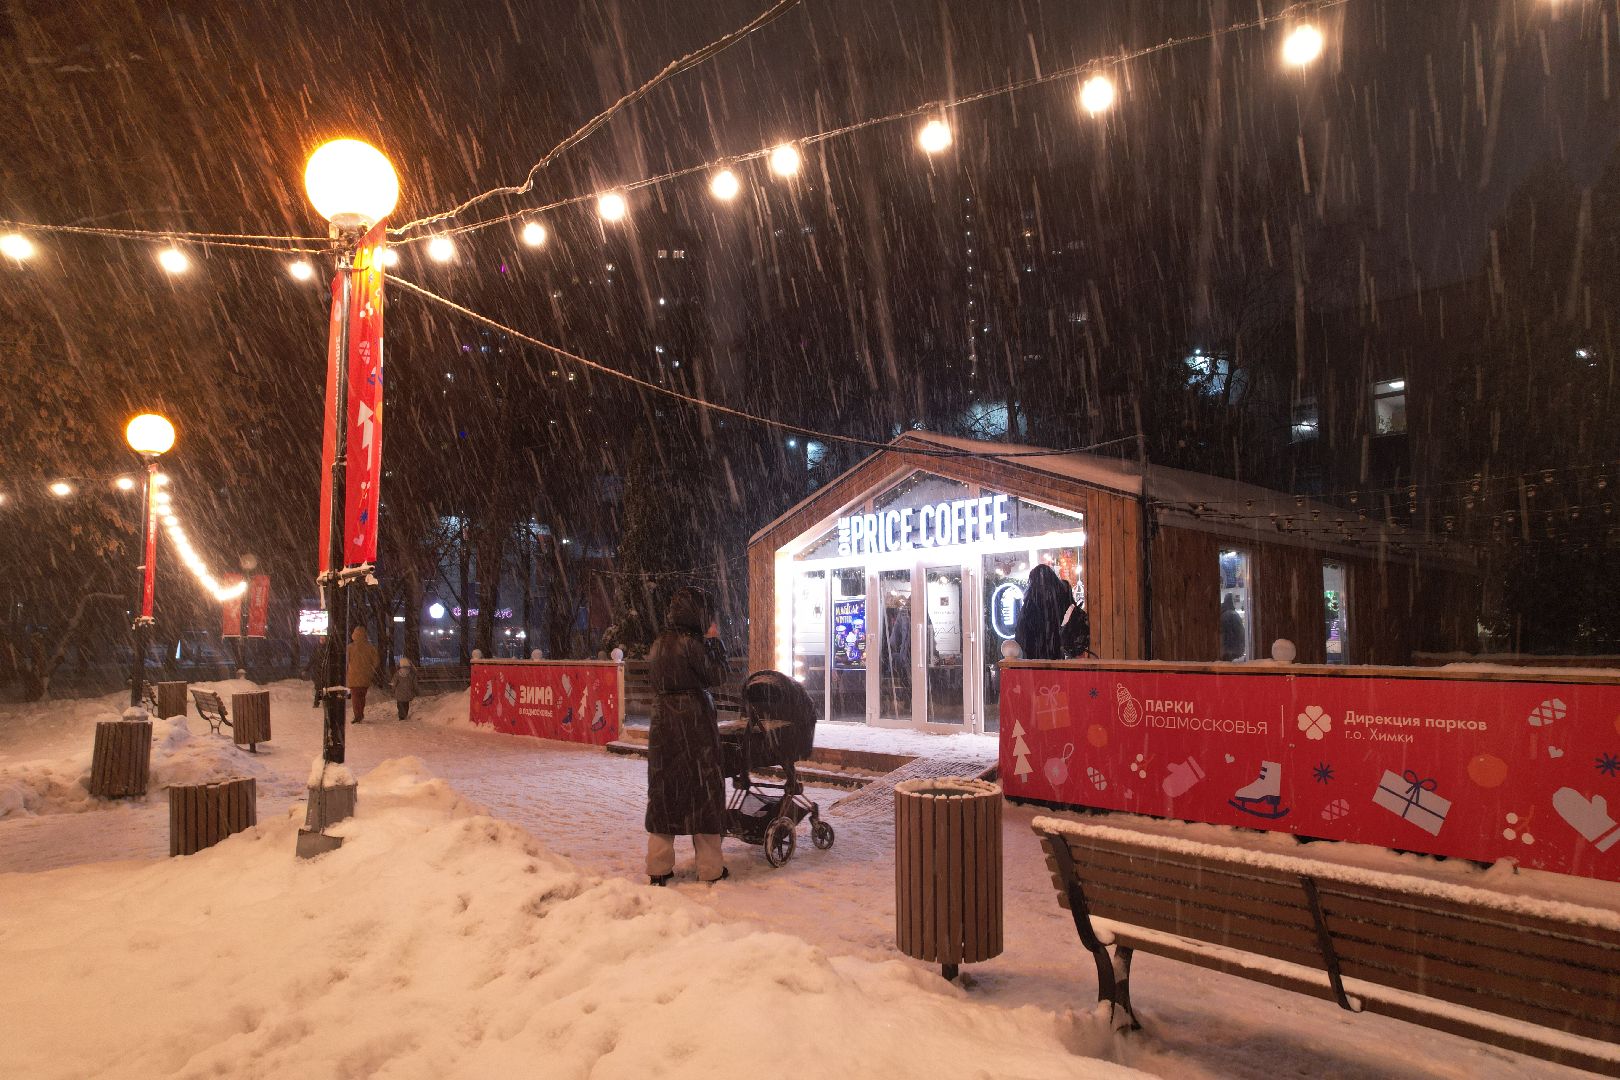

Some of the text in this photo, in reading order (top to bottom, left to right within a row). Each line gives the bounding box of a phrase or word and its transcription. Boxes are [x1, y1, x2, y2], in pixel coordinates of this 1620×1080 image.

[837, 494, 1009, 556] ONE PRICE COFFEE
[519, 685, 553, 705] ЗИМА
[1145, 699, 1194, 714] ПАРКИ
[1145, 715, 1268, 735] ПОДМОСКОВЬЯ
[1344, 710, 1488, 733] Дирекция парков
[1345, 728, 1414, 744] г.о. Химки
